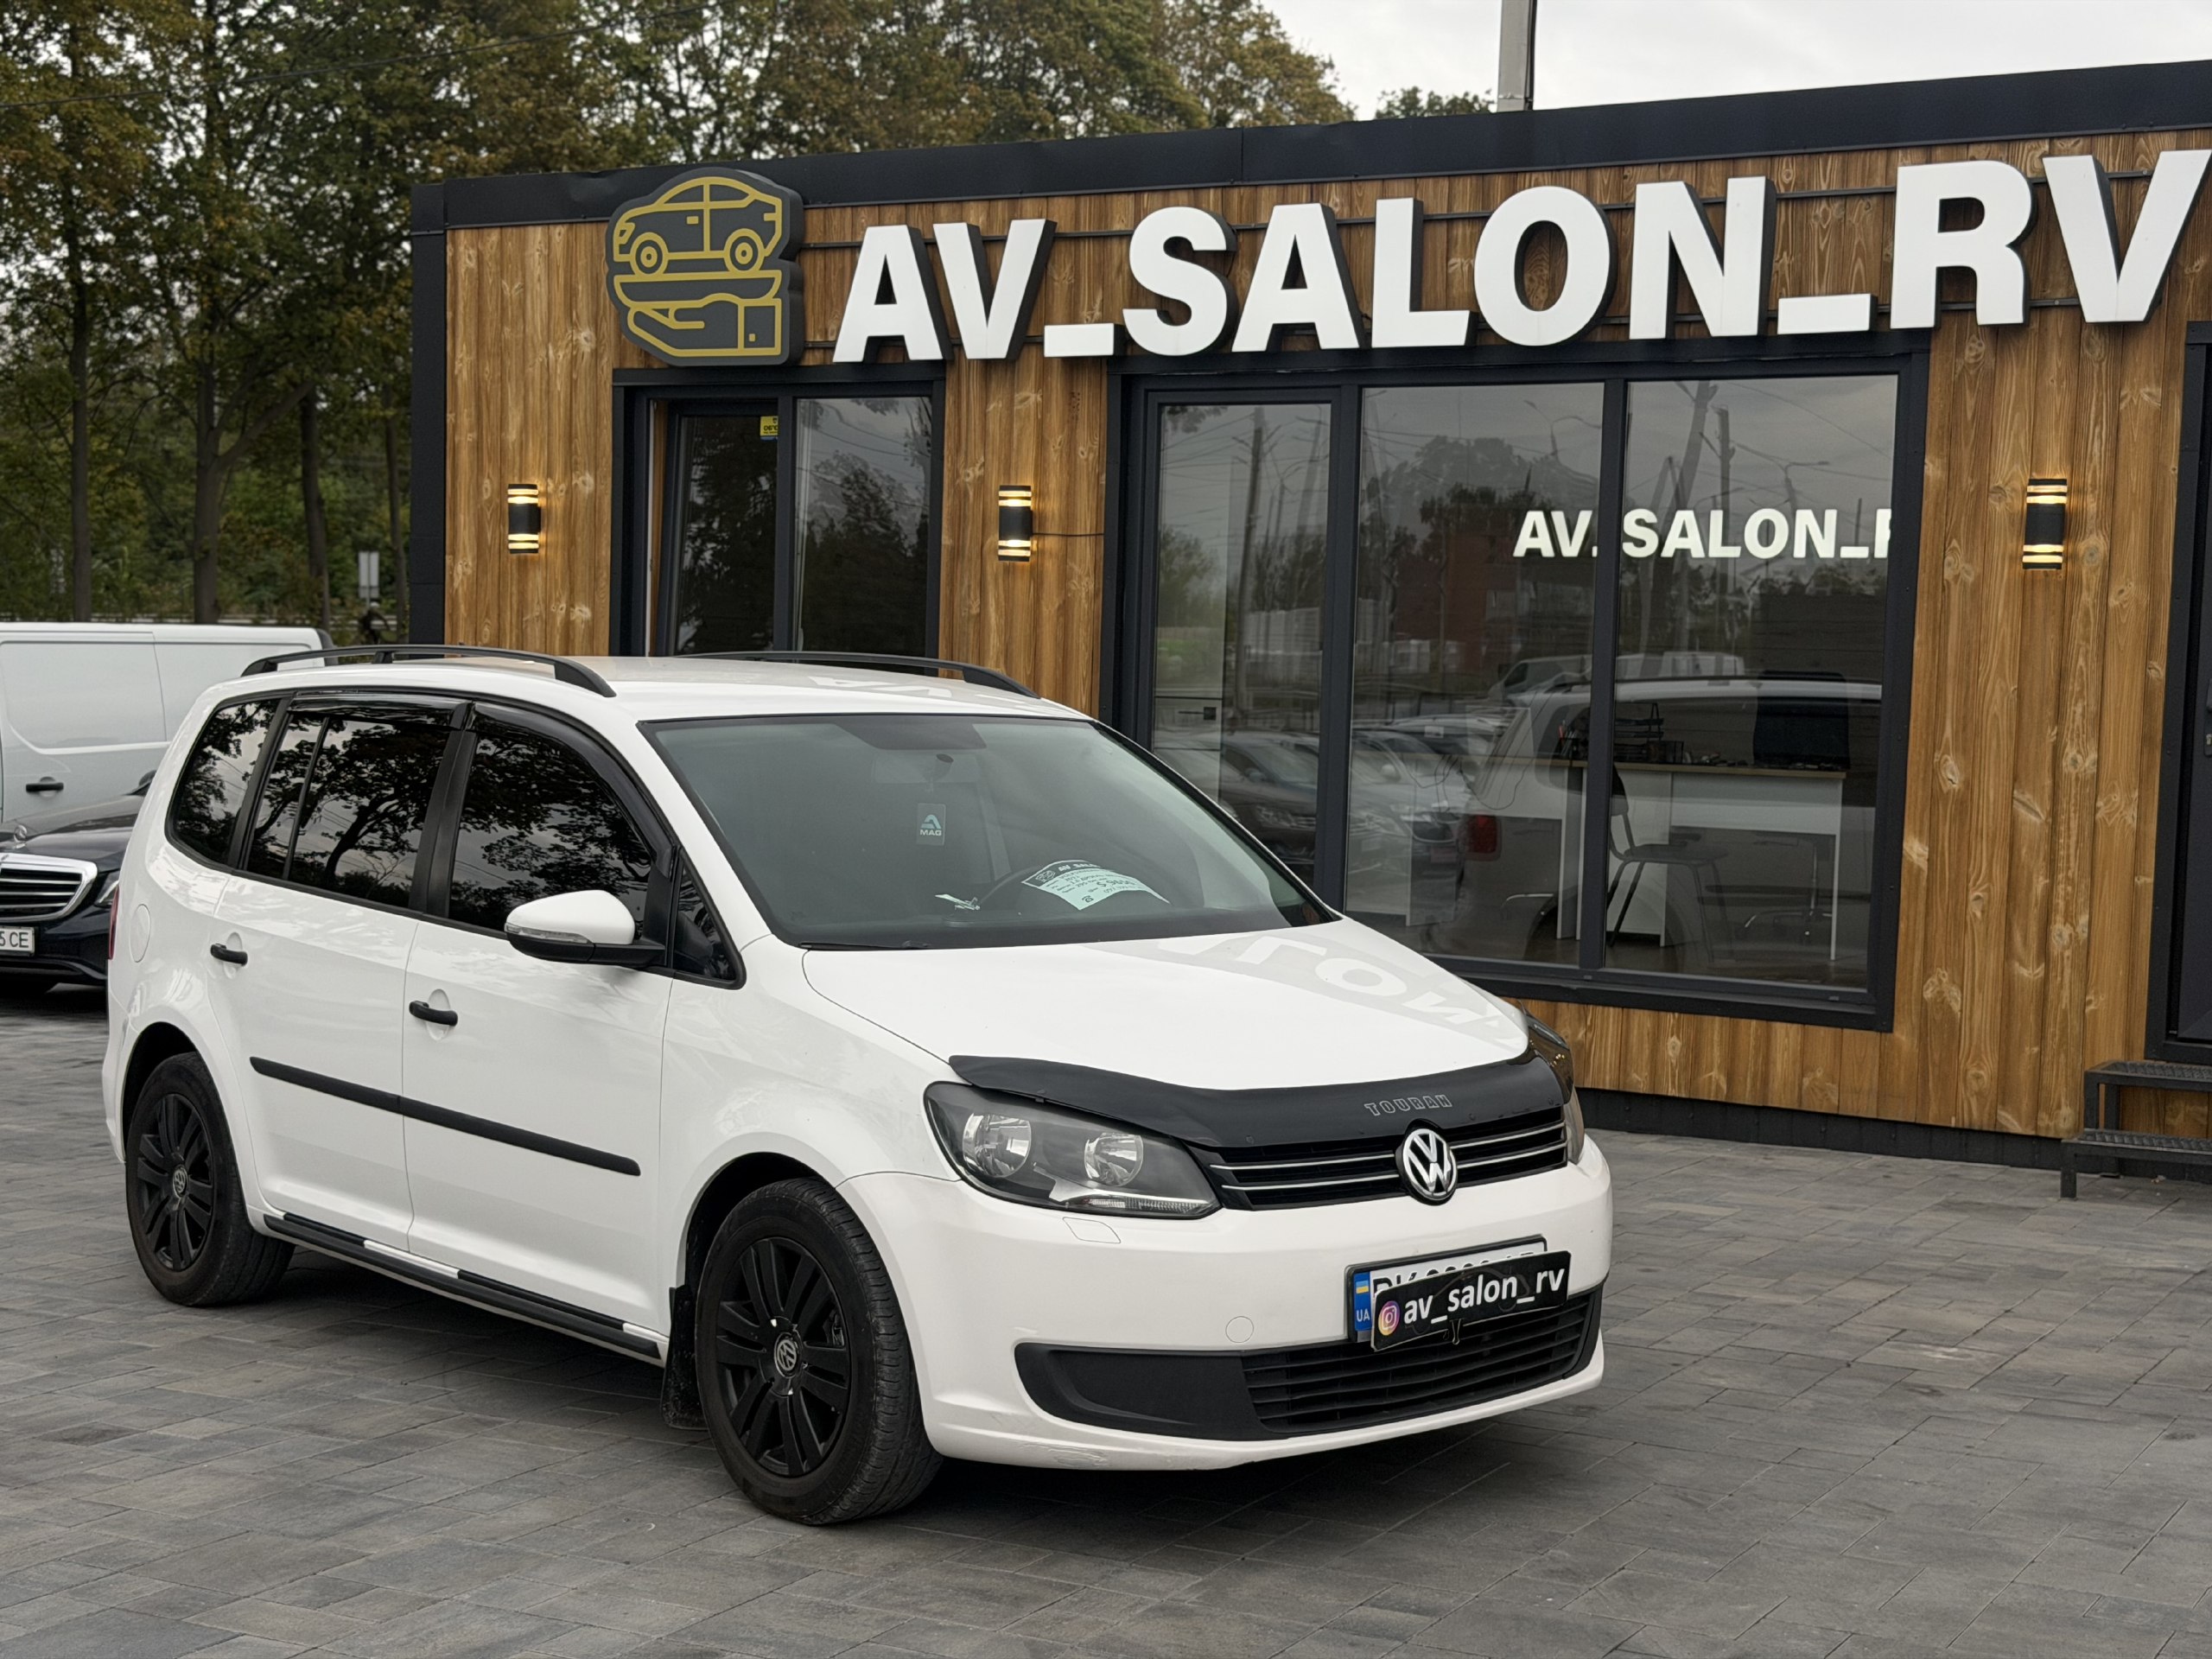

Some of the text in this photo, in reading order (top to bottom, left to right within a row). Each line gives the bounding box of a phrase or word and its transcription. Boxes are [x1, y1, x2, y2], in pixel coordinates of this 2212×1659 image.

[832, 149, 2212, 363] AV_SALON_RV
[10, 931, 29, 949] CE
[1363, 1094, 1453, 1116] TOURAN
[1403, 1268, 1566, 1325] av_salon_rv
[1356, 1309, 1370, 1323] UA
